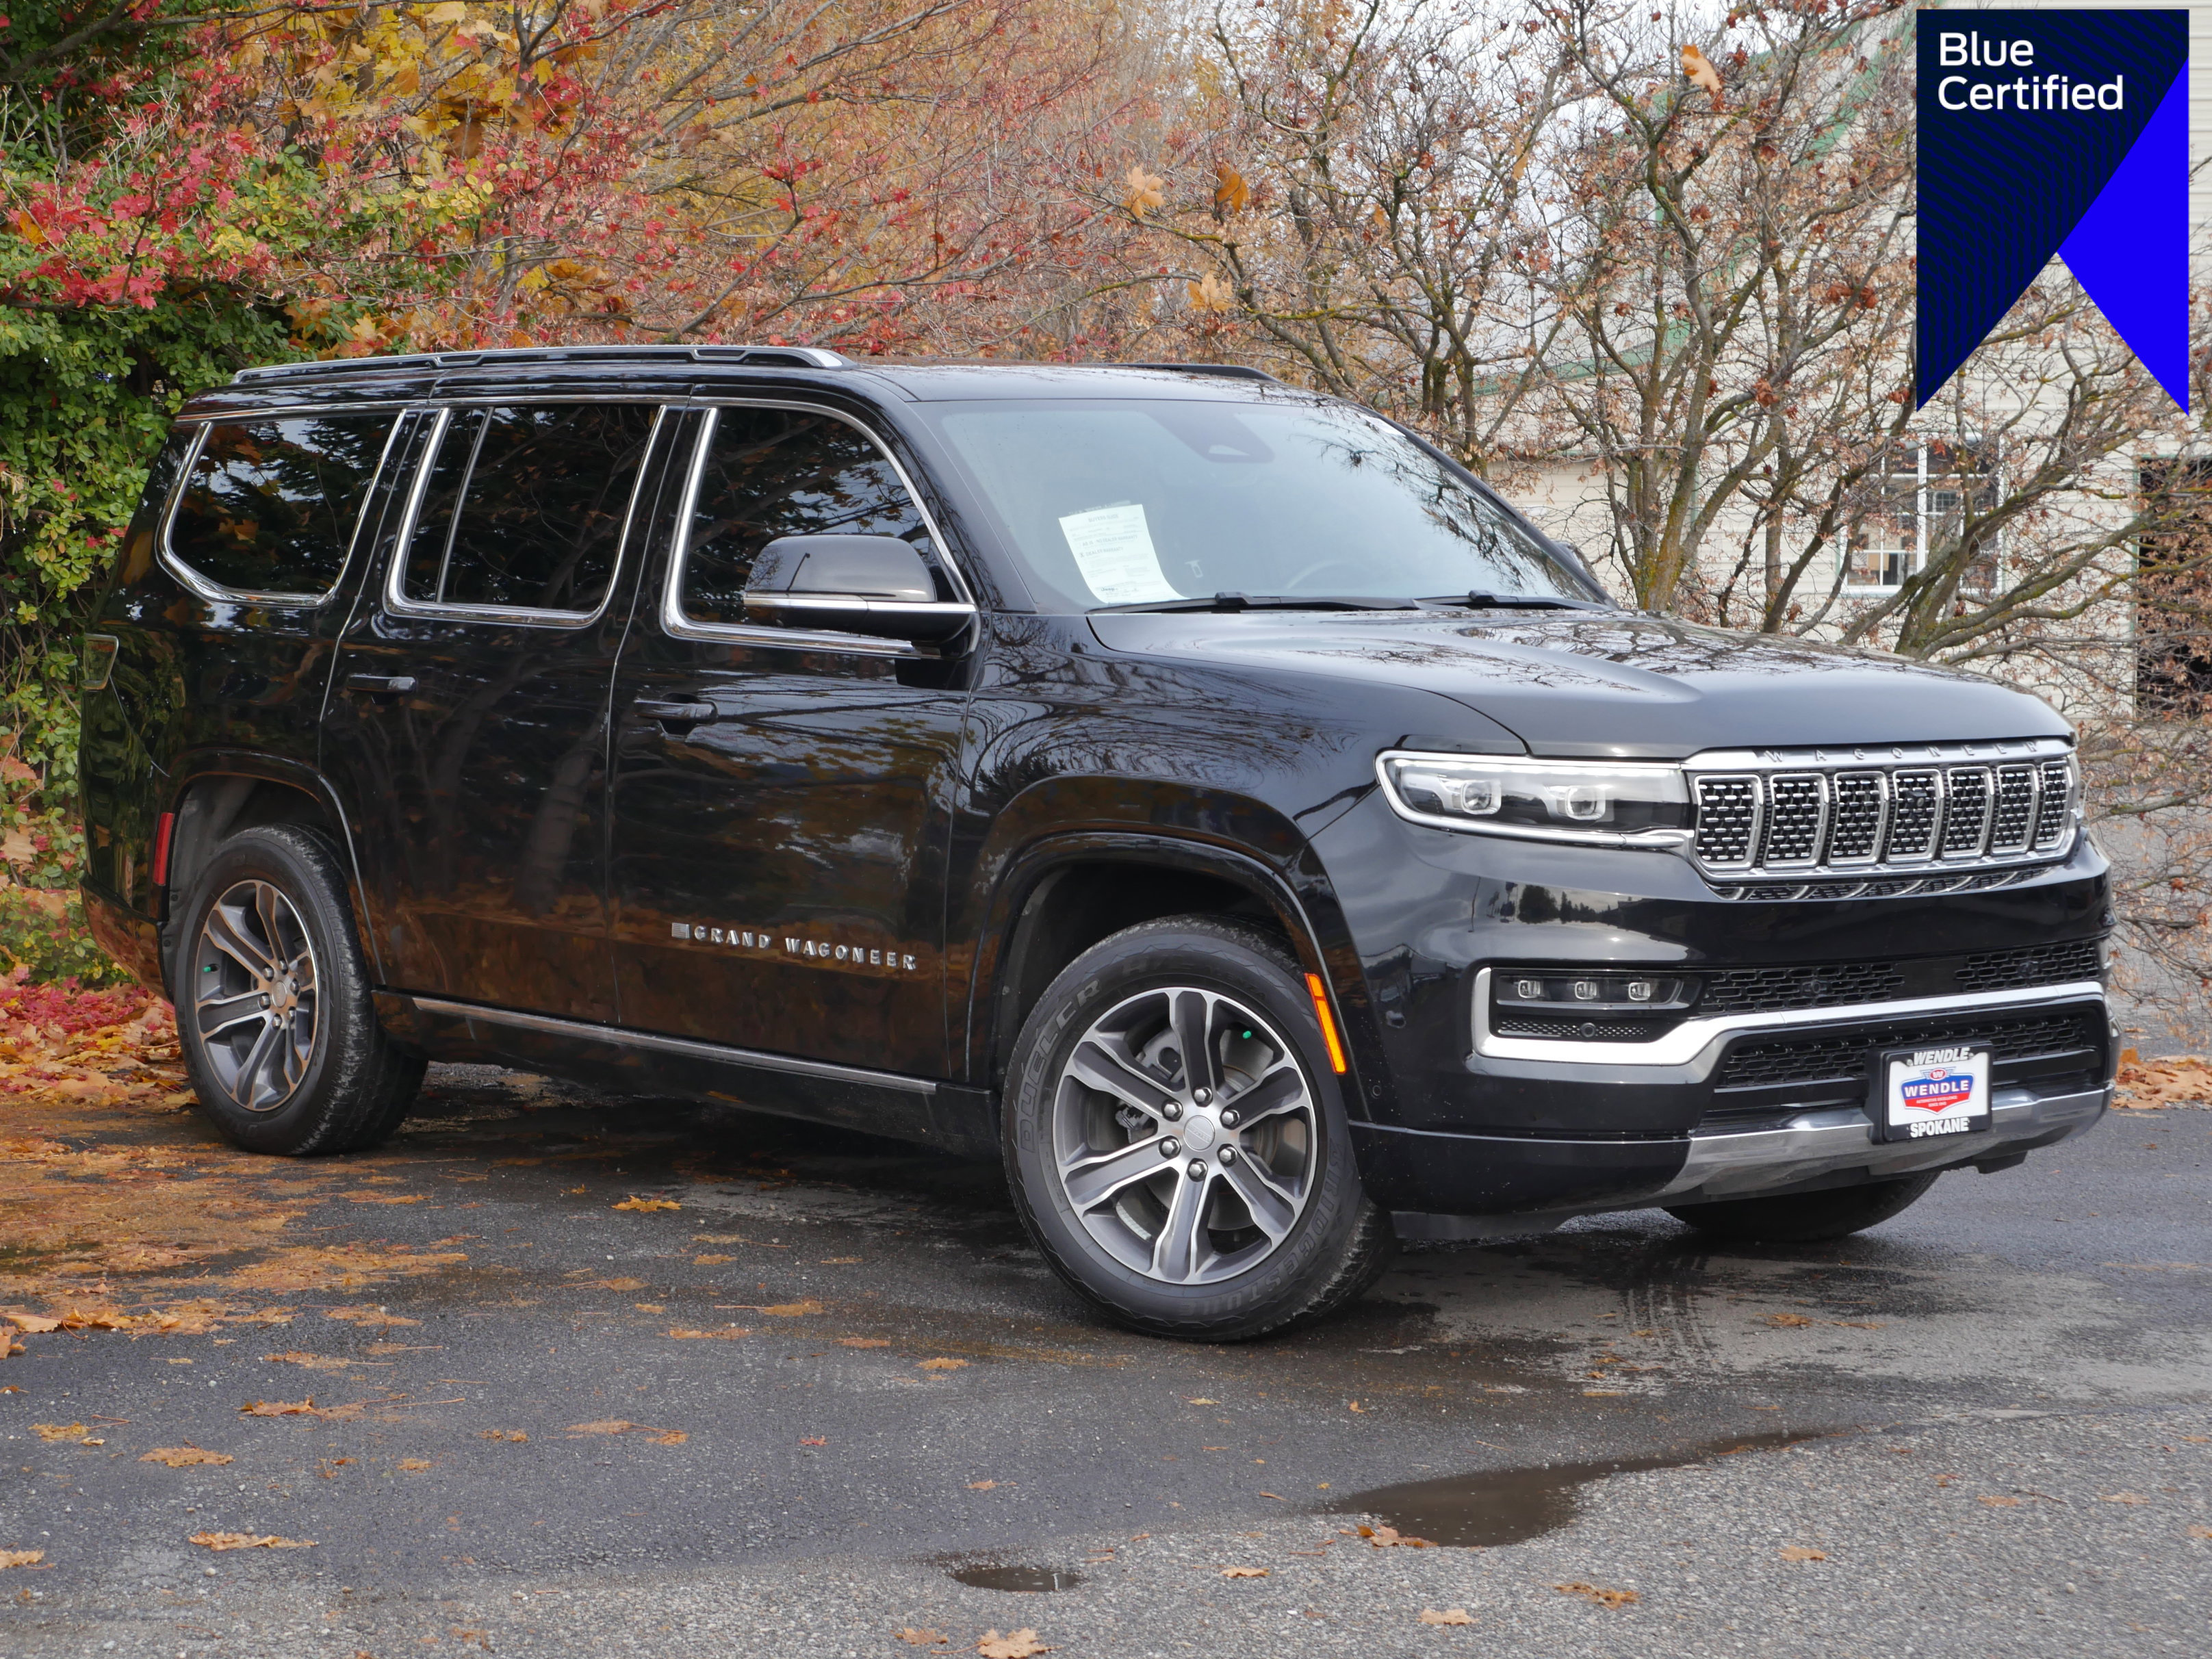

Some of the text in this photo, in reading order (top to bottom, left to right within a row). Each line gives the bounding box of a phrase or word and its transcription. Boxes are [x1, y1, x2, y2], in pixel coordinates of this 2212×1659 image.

[1764, 742, 2038, 762] WAGONEER
[694, 925, 917, 970] GRAND WAGONEER
[1914, 1047, 1970, 1065] WENDLE
[1905, 1081, 1968, 1096] WENDLE
[1910, 1117, 1970, 1138] SPOKANE
